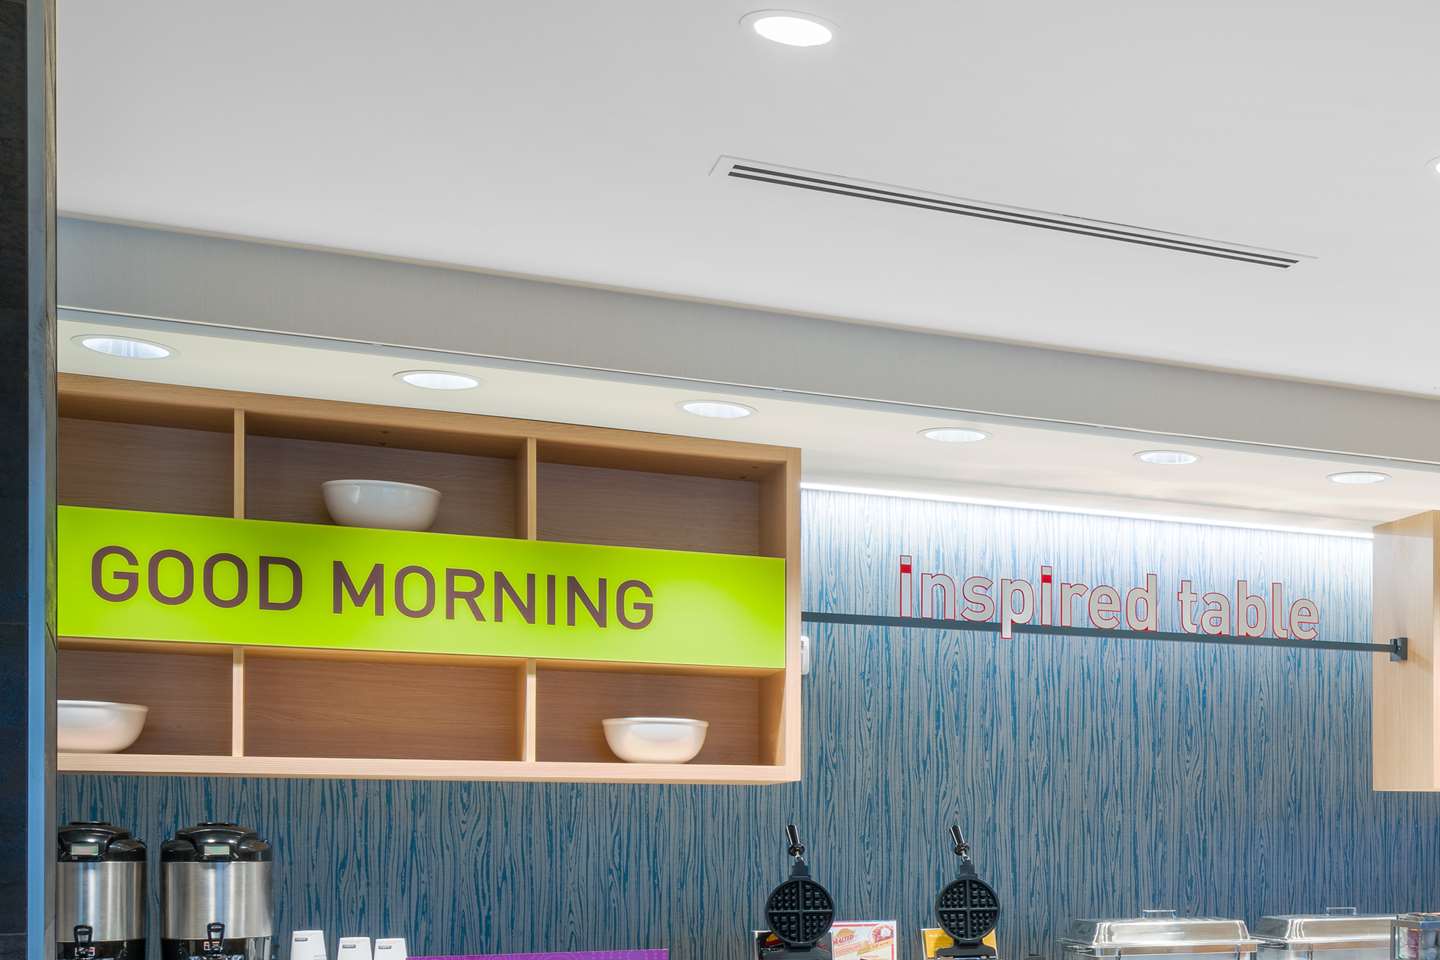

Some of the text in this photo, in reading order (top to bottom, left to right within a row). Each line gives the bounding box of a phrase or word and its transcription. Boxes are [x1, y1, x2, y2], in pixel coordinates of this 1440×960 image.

[91, 545, 655, 631] GOOD MORNING
[899, 554, 1320, 640] inspired table
